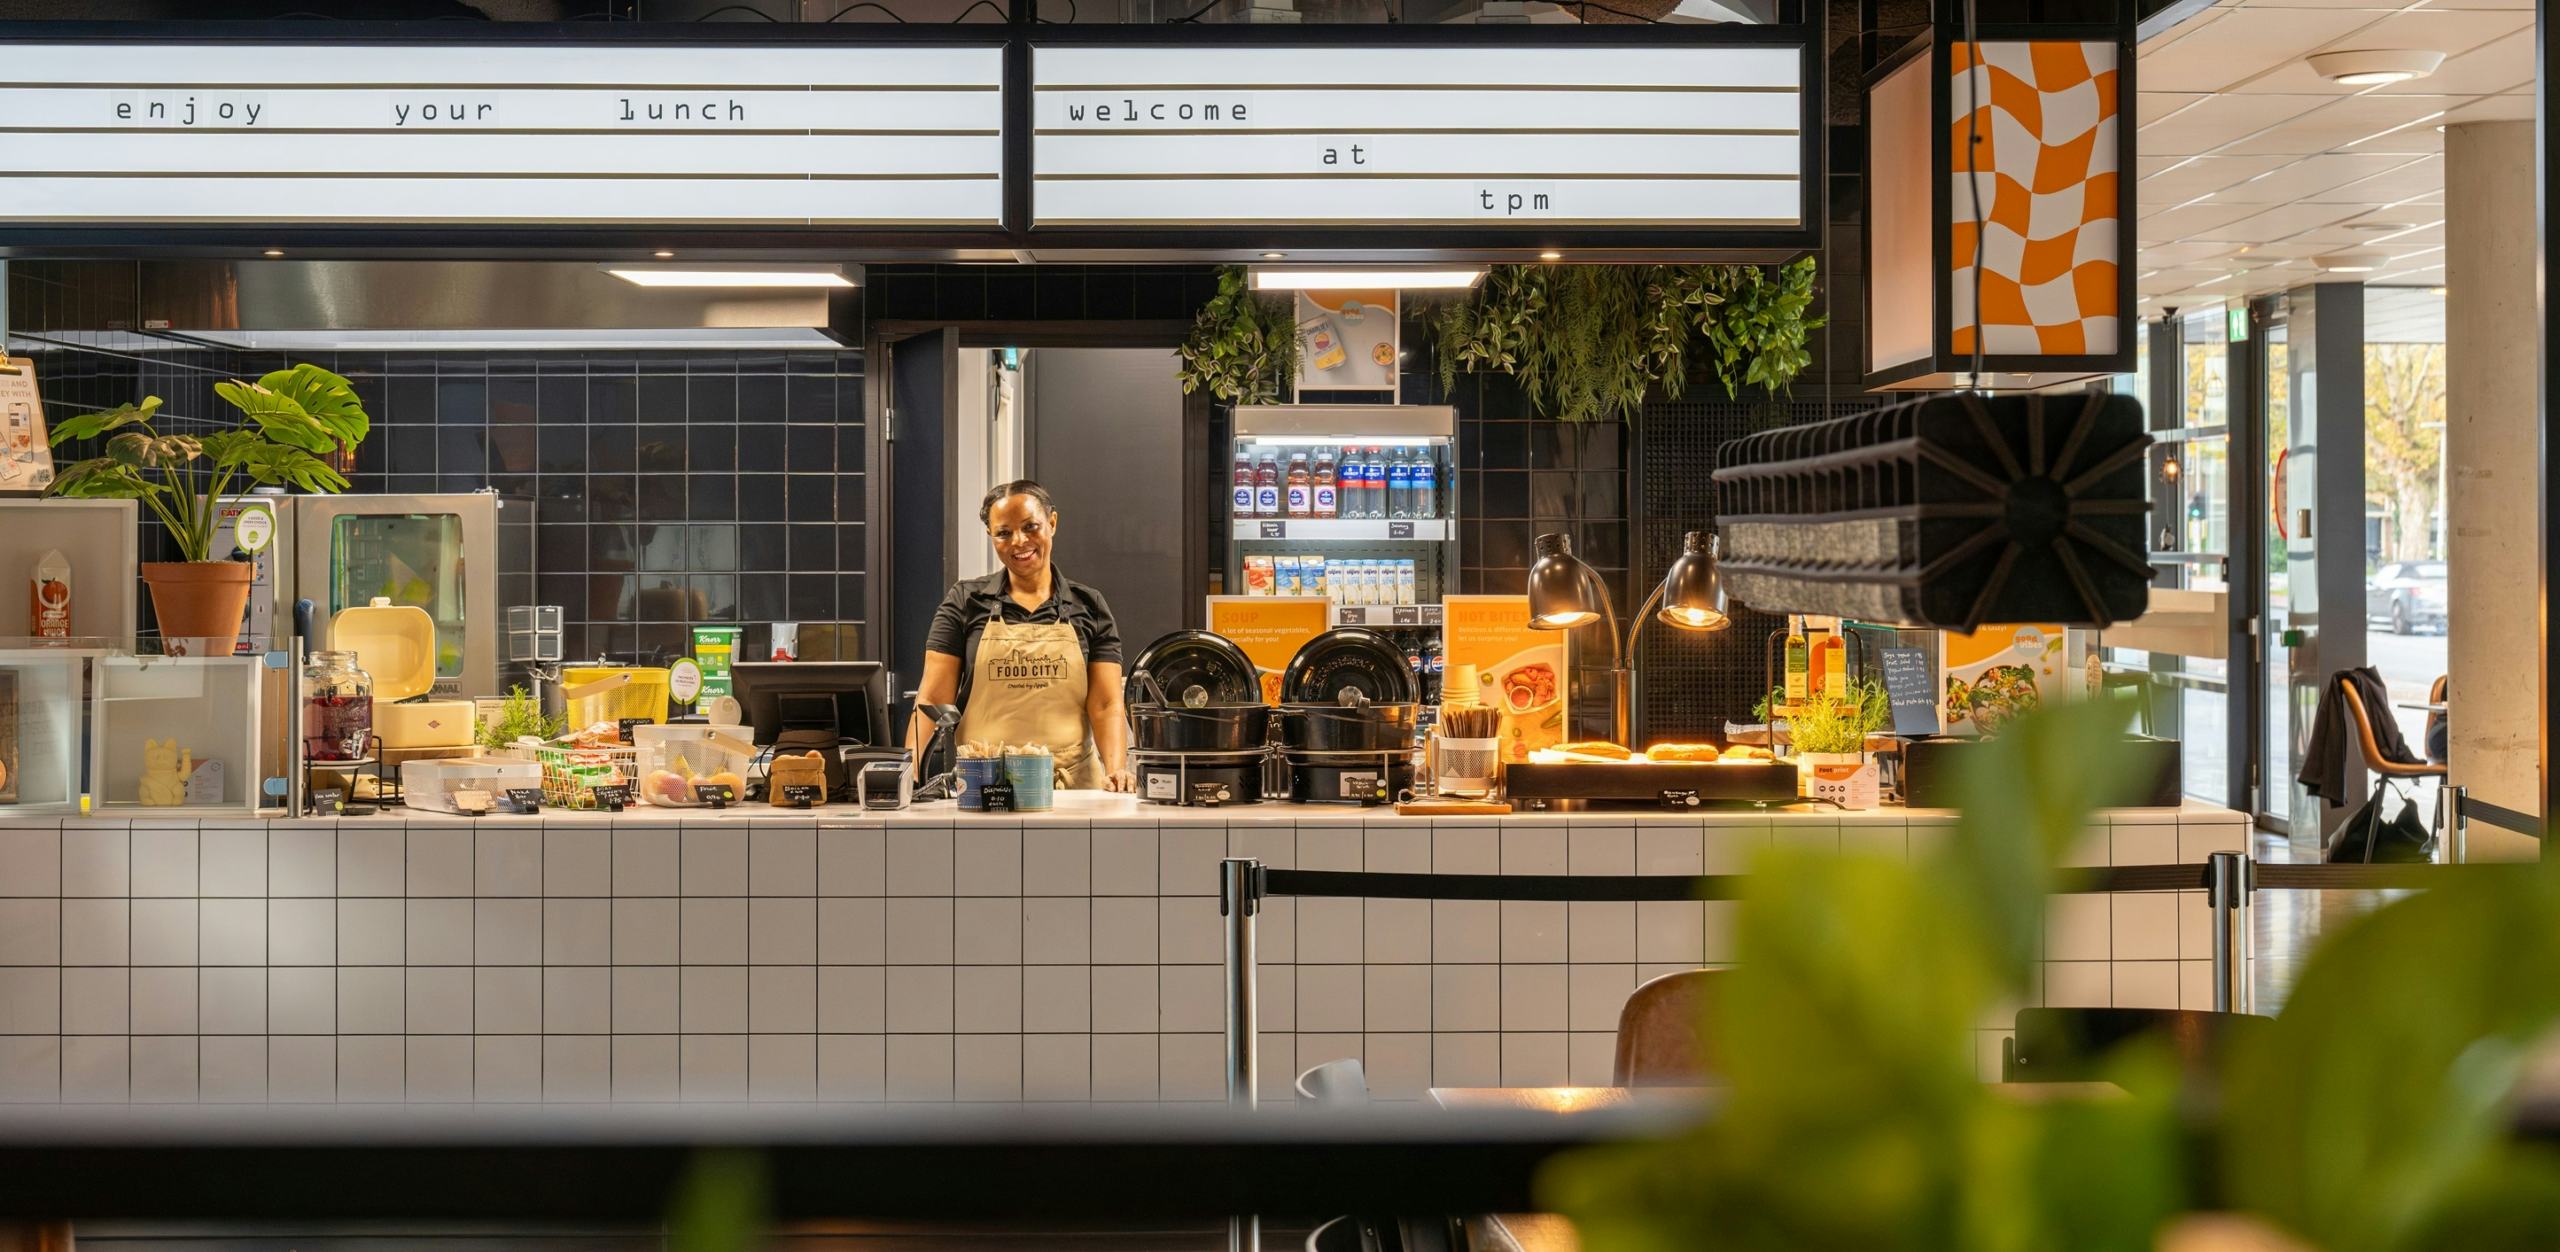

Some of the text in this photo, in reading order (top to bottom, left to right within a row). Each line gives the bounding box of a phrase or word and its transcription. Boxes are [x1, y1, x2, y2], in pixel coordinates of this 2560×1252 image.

[116, 98, 745, 125] enjoy your lunch
[1069, 99, 1247, 122] welcome
[1322, 144, 1366, 166] at
[1480, 189, 1550, 214] tpm
[1221, 612, 1259, 623] SOUP
[1459, 611, 1529, 622] HOT BITES
[41, 619, 69, 629] ORANGE
[1274, 627, 1311, 636] vegetables,
[699, 635, 721, 644] Knorr
[2019, 641, 2042, 649] vibes
[997, 665, 1059, 677] FOOD CITY
[701, 685, 724, 694] Knorr
